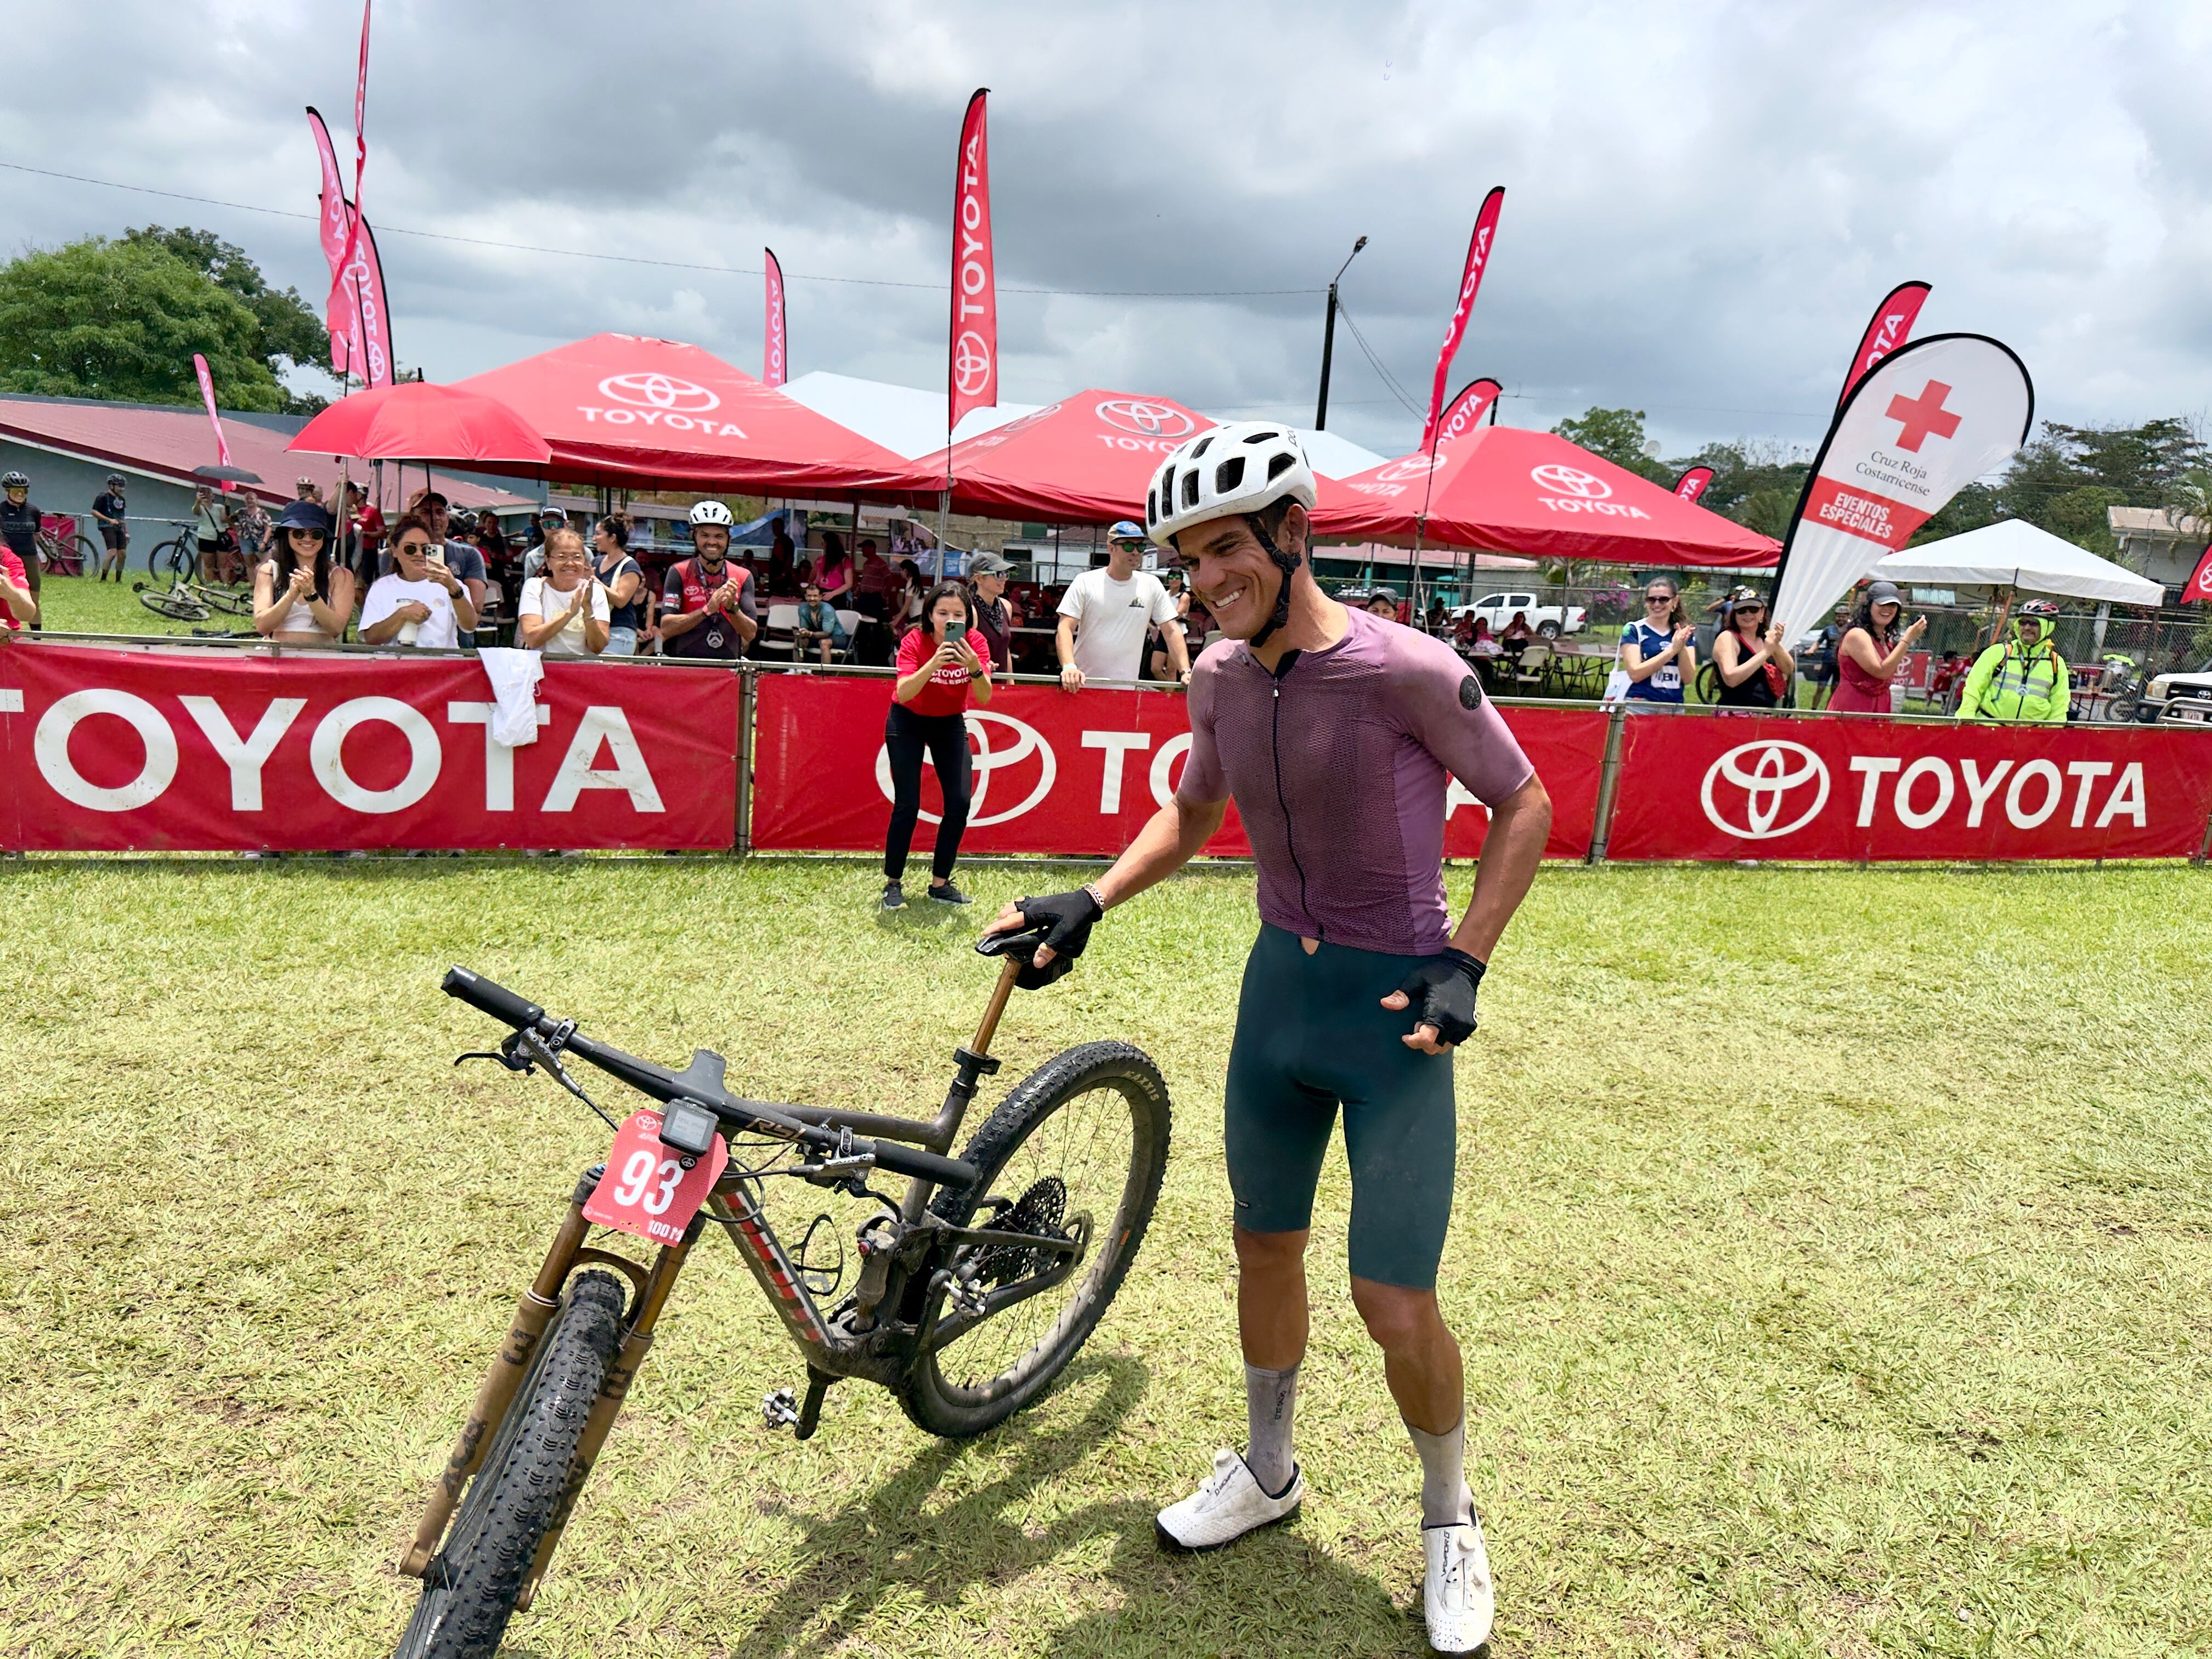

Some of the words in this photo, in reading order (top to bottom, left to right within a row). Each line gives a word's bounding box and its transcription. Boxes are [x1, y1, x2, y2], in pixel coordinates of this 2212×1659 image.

[960, 134, 987, 323] TOYOTA
[577, 406, 749, 439] TOYOTA
[1097, 435, 1180, 455] TOYO
[1856, 461, 1930, 496] Costarricense
[1871, 450, 1899, 469] Cruz
[1900, 460, 1927, 479] Roja
[1537, 497, 1652, 520] TOYOTA
[1819, 503, 1893, 539] ESPECIALES
[1834, 492, 1890, 522] EVENTOS
[0, 687, 667, 813] OYOTA
[1849, 755, 2147, 830] TOYOTA
[614, 1150, 685, 1215] 93
[647, 1220, 671, 1238] 100
